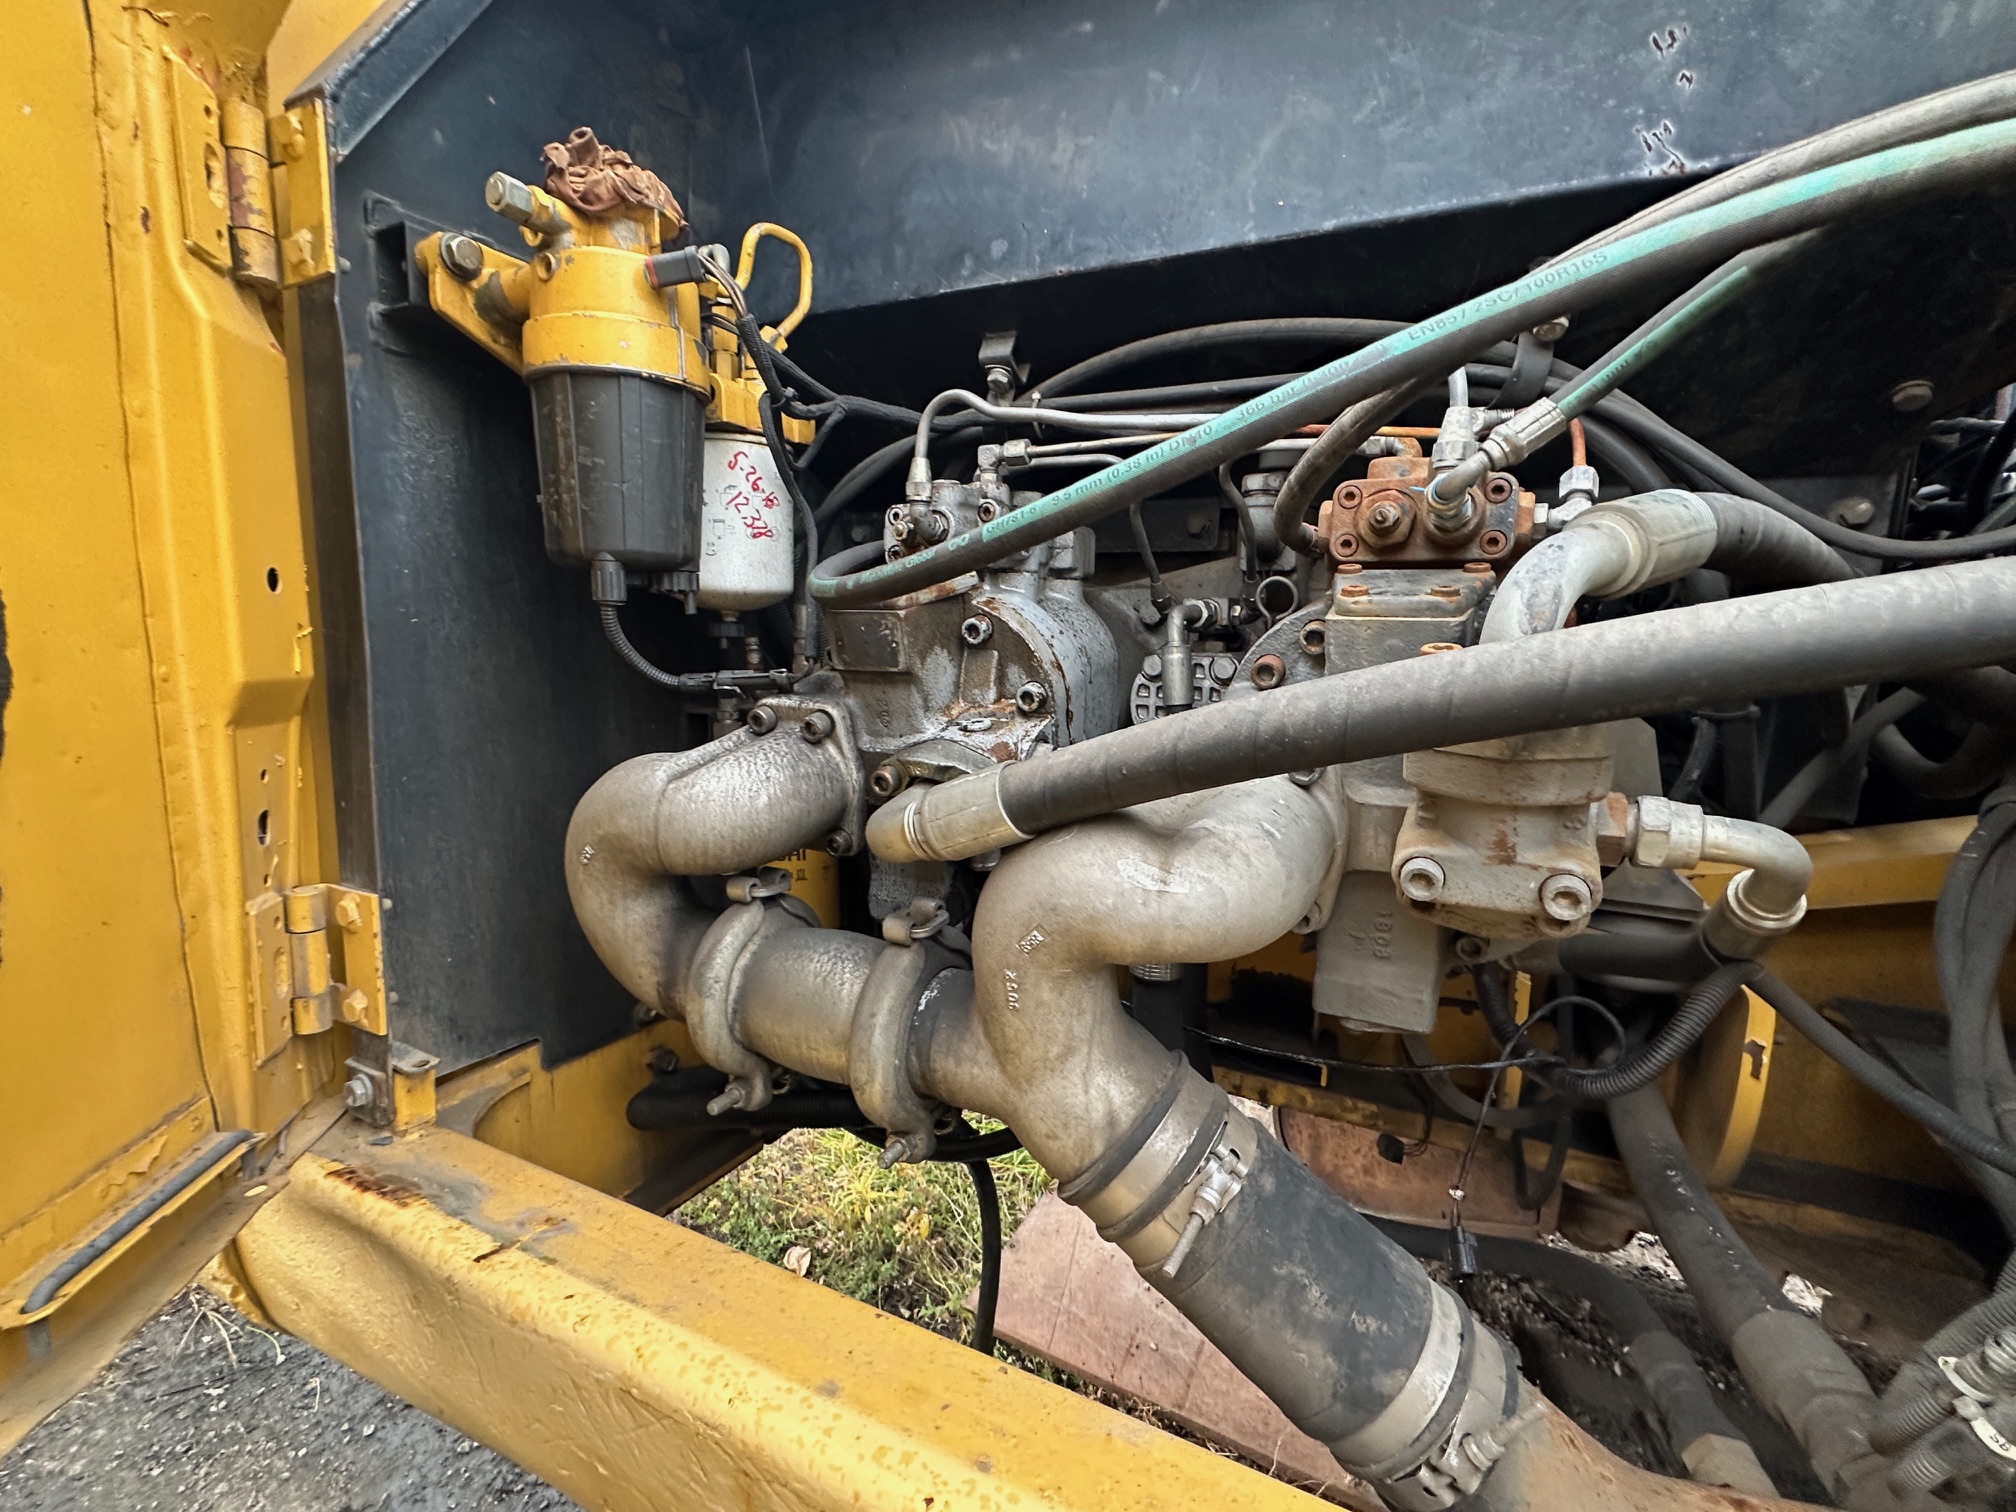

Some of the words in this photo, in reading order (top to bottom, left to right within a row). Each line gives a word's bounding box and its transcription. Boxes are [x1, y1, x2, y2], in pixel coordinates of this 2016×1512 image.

[1075, 476, 1104, 497] mm
[1235, 400, 1266, 422] 366
[1269, 384, 1300, 406] bar
